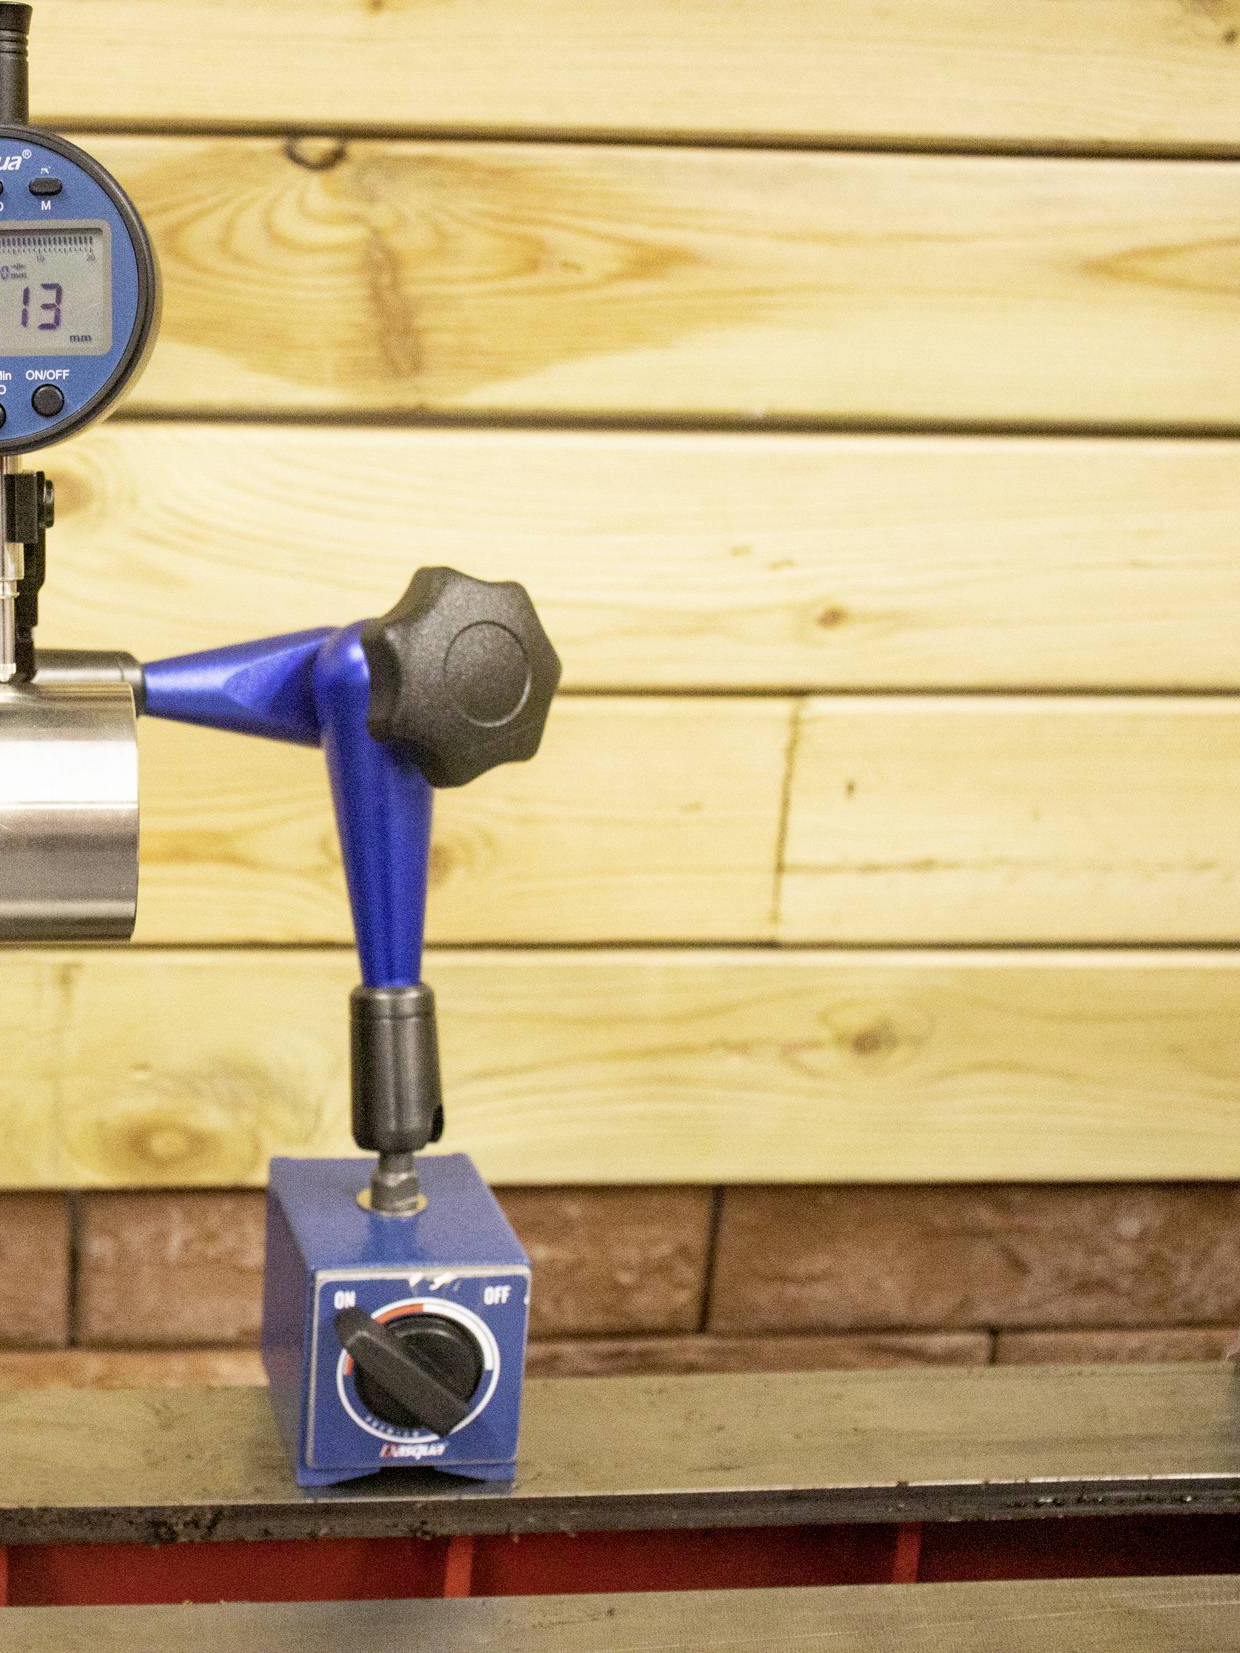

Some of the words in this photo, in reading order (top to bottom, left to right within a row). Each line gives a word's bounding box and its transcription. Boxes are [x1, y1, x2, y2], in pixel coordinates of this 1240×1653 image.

[41, 200, 52, 211] M
[25, 369, 70, 381] ON/OFF
[334, 1291, 357, 1310] ON
[484, 1285, 512, 1305] OFF
